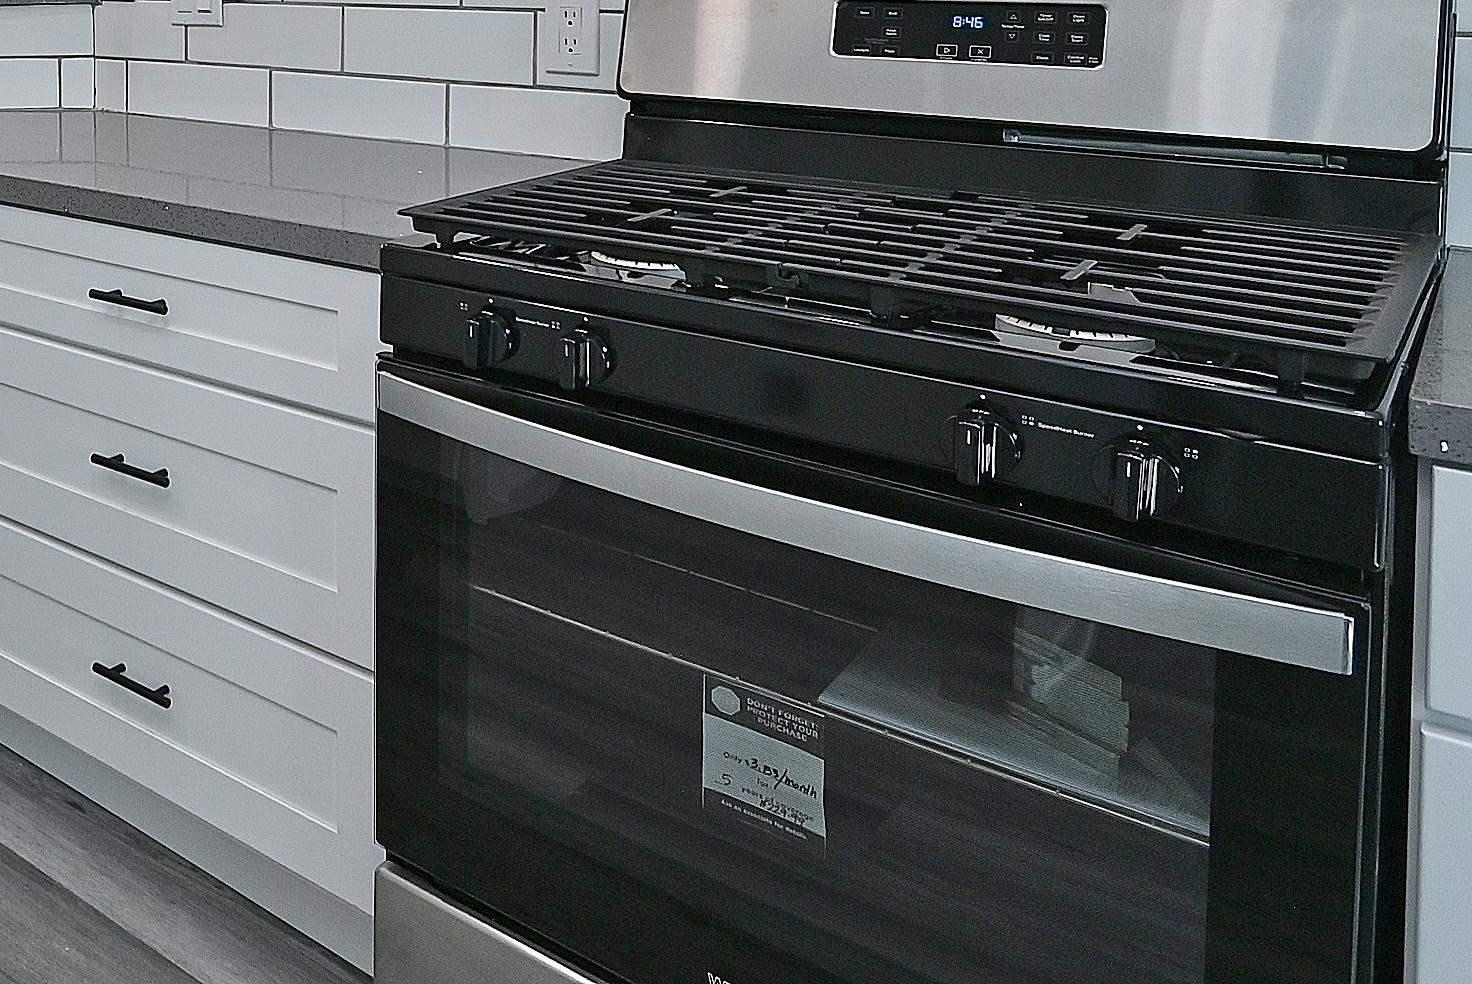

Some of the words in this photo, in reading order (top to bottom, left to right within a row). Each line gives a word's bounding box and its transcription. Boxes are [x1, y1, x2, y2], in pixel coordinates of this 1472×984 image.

[952, 15, 984, 29] 8:46
[757, 717, 808, 742] PURCHASE
[792, 722, 819, 739] YOUR
